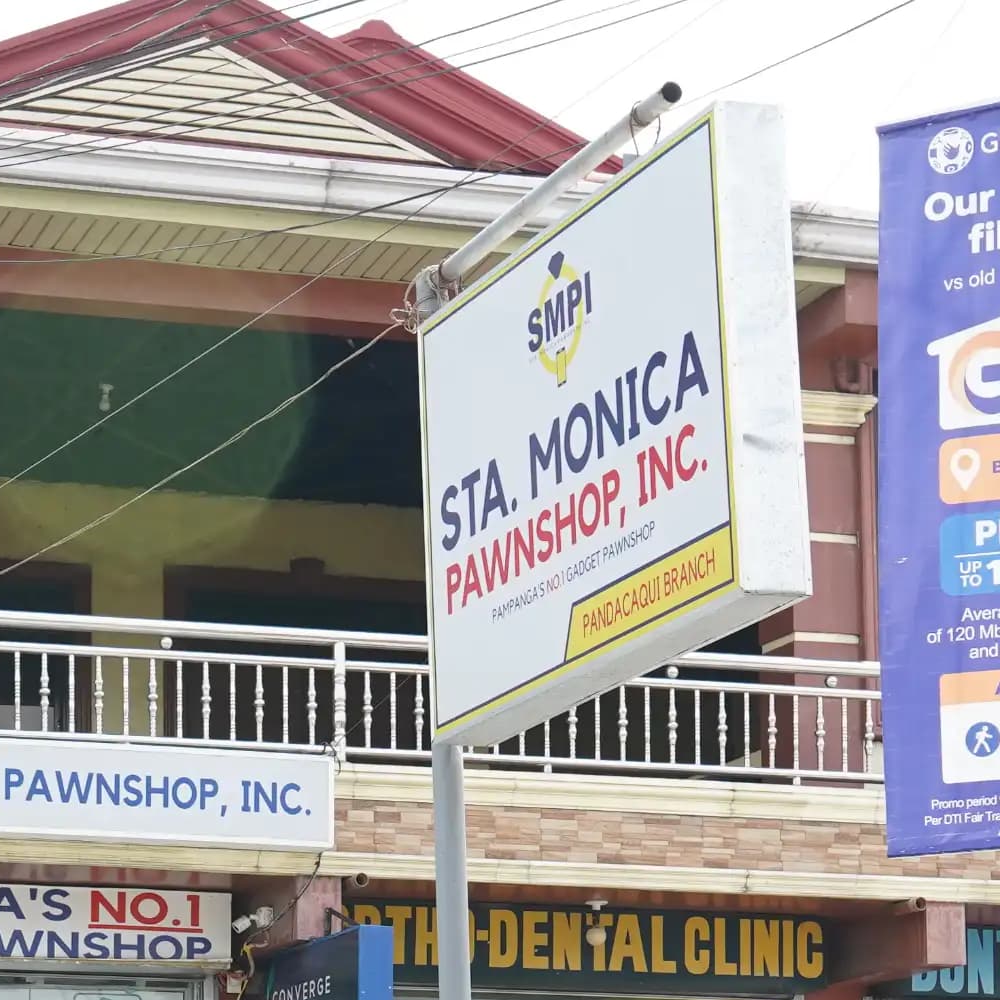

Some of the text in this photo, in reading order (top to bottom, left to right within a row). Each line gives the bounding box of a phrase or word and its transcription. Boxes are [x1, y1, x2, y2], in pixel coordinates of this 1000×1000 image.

[924, 189, 996, 221] Our
[943, 268, 995, 291] vs old
[528, 270, 592, 352] SMPI
[441, 330, 709, 551] STA. MONICA
[446, 424, 708, 615] PAWNSHOP, INC.
[492, 580, 545, 624] PAMPANGA'S
[566, 550, 601, 584] GADGET
[602, 520, 656, 564] PAWNSHOP
[960, 560, 982, 574] UP
[960, 575, 982, 588] TO
[583, 547, 716, 638] PANDACAQUI BRANCH
[927, 625, 975, 643] of 120
[969, 643, 998, 659] and
[4, 767, 227, 817] PAWNSHOP,
[241, 780, 311, 815] INC.
[931, 794, 997, 810] Promo period
[924, 815, 943, 826] Per
[964, 812, 984, 823] Fair
[90, 889, 201, 928] NO.1
[684, 916, 824, 979] CLINIC
